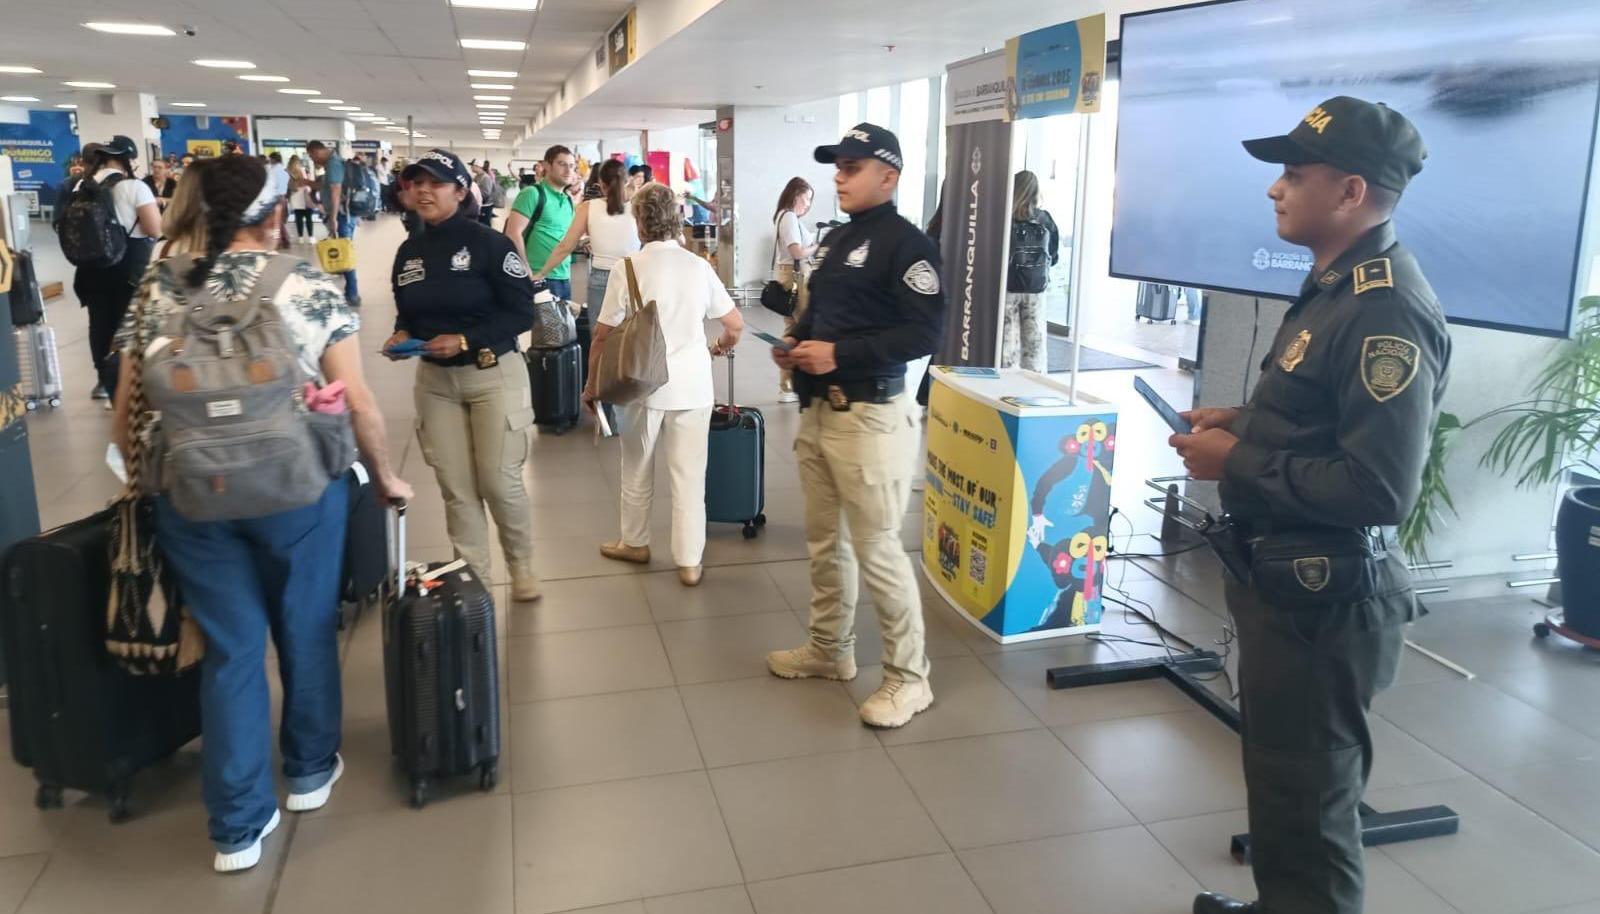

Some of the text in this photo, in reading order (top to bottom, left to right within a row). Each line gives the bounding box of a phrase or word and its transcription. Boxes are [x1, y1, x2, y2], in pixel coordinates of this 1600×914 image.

[1304, 106, 1333, 134] CIA
[961, 179, 979, 361] BARRANQUILLA
[948, 468, 965, 493] MOST
[967, 480, 977, 498] OF
[979, 486, 997, 507] OUR
[953, 491, 971, 517] STAY
